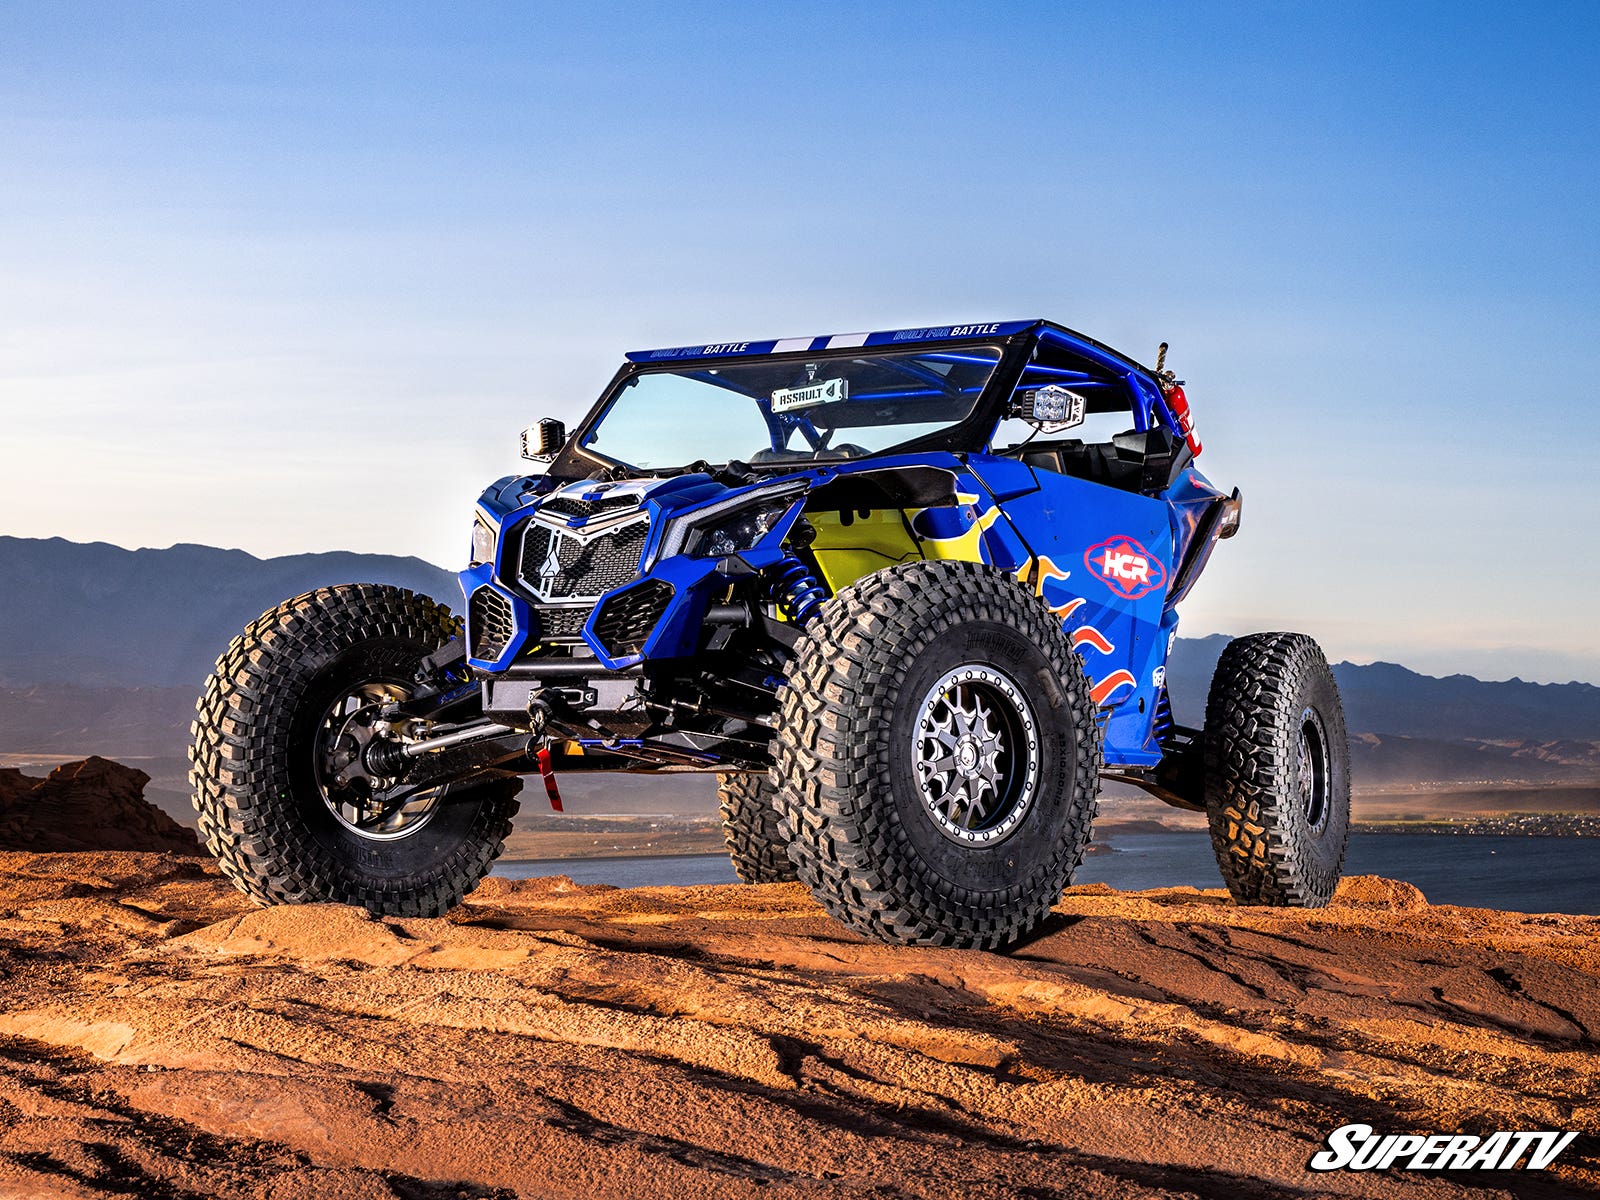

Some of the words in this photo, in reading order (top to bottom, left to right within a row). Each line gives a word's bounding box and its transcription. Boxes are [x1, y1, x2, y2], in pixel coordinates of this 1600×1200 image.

[950, 323, 1000, 337] BATTLE
[702, 342, 750, 355] BATTLE
[779, 387, 824, 406] ASSAULT
[1103, 549, 1150, 583] HCR
